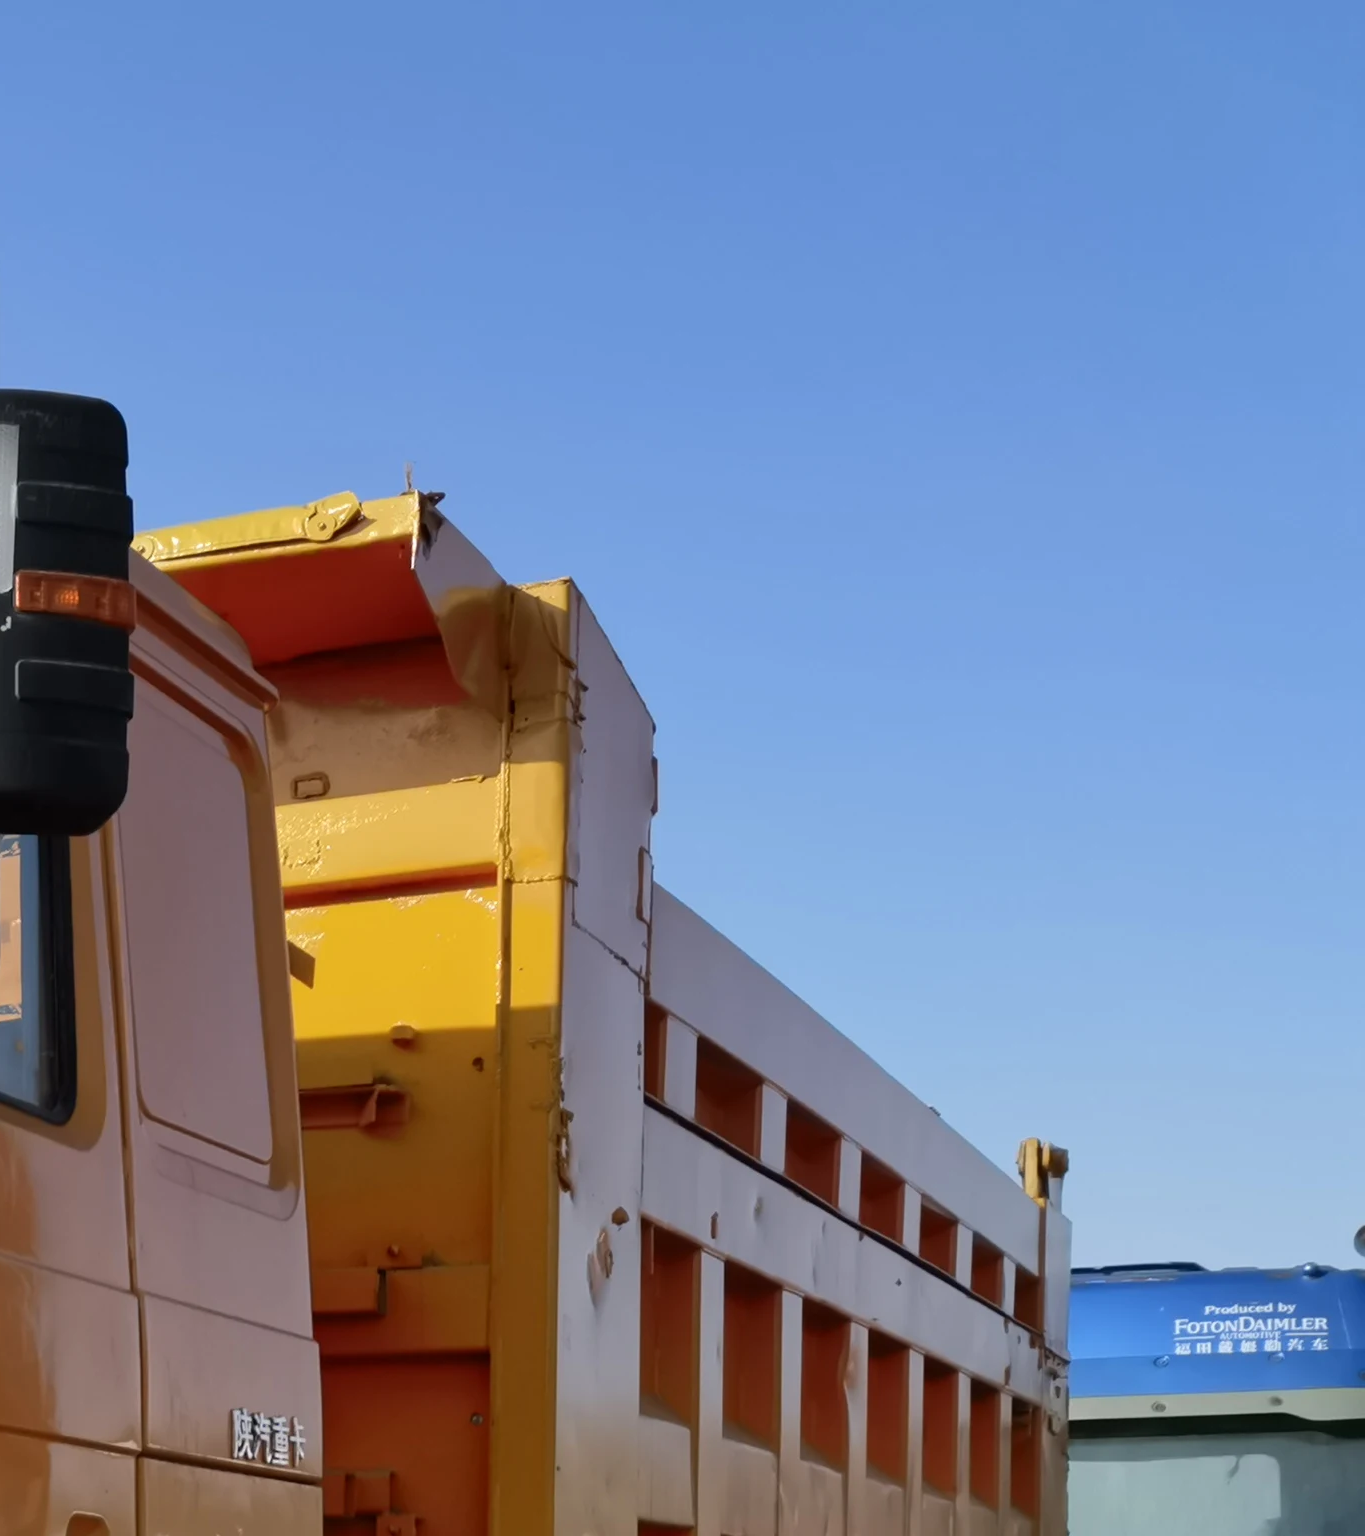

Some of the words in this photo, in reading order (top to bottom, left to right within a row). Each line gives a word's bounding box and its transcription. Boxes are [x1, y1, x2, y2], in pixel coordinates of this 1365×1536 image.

[1204, 1302, 1273, 1316] Produced
[1278, 1302, 1296, 1314] by
[1219, 1331, 1281, 1340] AUTOMOTIVE
[230, 1407, 306, 1468] 陕汽重卡
